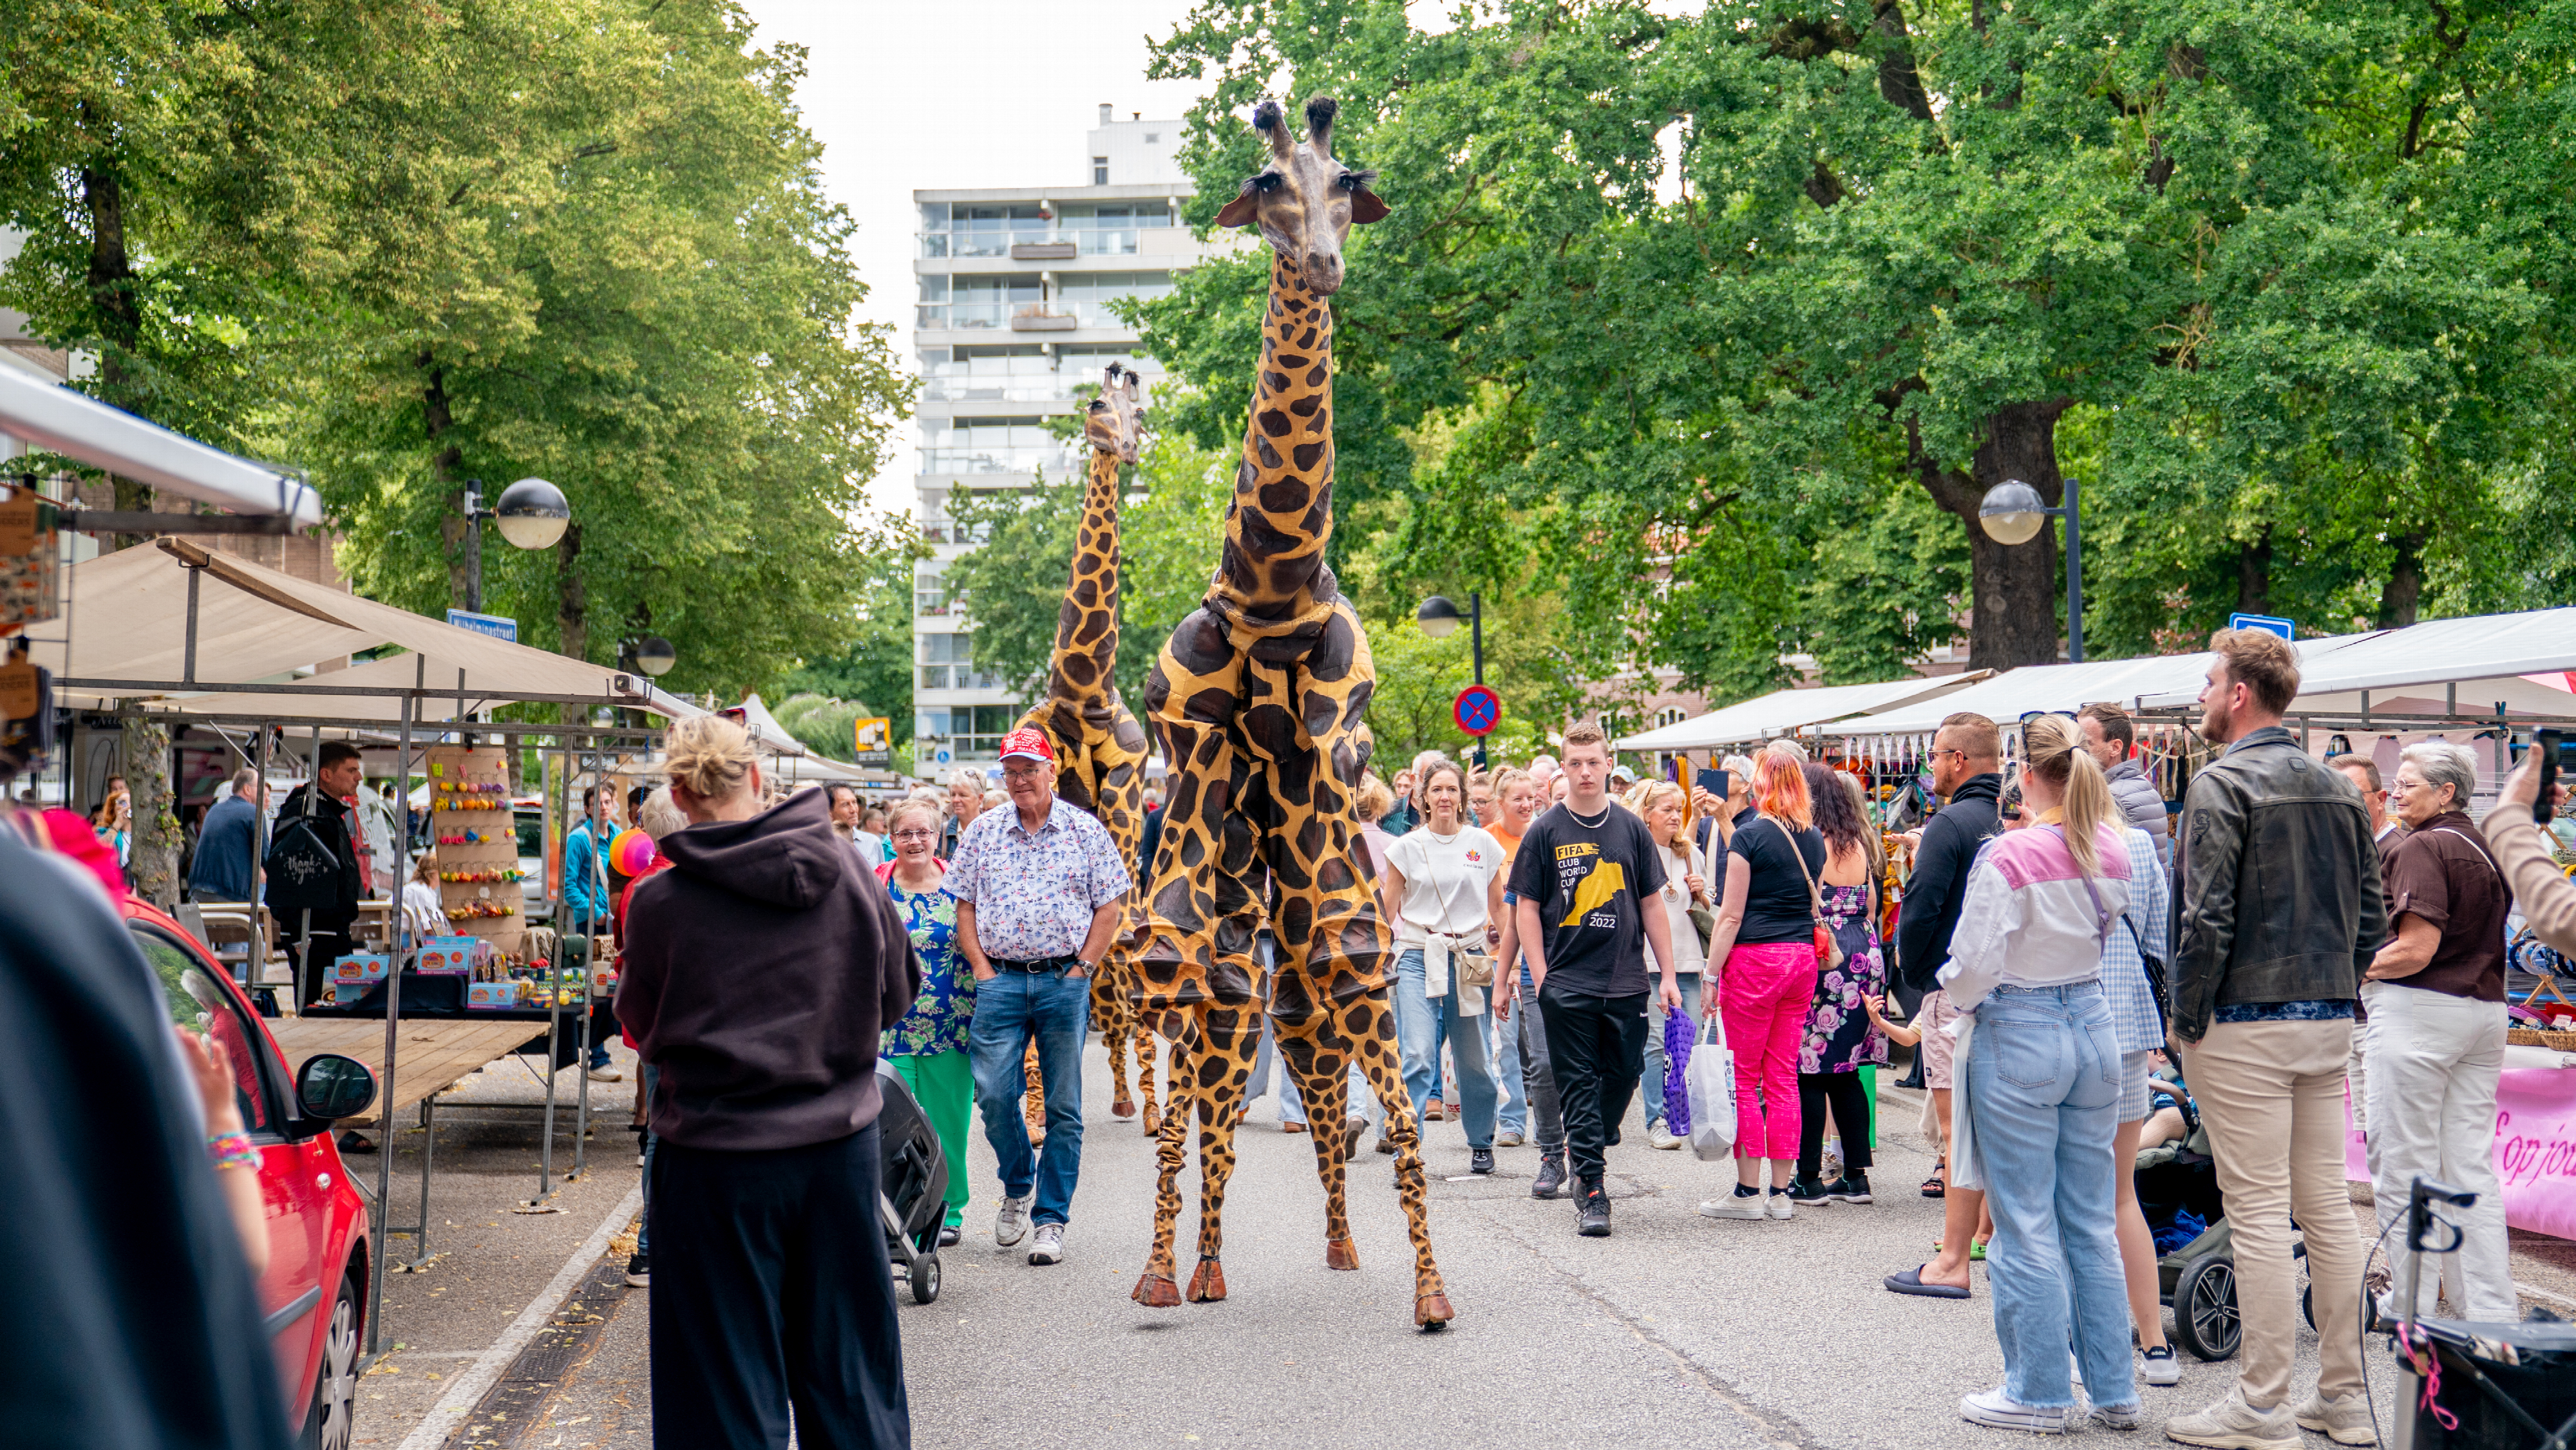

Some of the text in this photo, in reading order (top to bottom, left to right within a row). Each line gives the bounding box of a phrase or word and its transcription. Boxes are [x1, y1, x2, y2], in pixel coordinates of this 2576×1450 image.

[453, 618, 513, 640] Wilhelminastraat
[1557, 845, 1584, 858] FIFA
[1558, 858, 1580, 869] CLUB
[1559, 866, 1587, 878] WORLD
[1561, 877, 1575, 888] CUP
[1589, 917, 1615, 928] 2022
[2503, 1136, 2540, 1185] op
